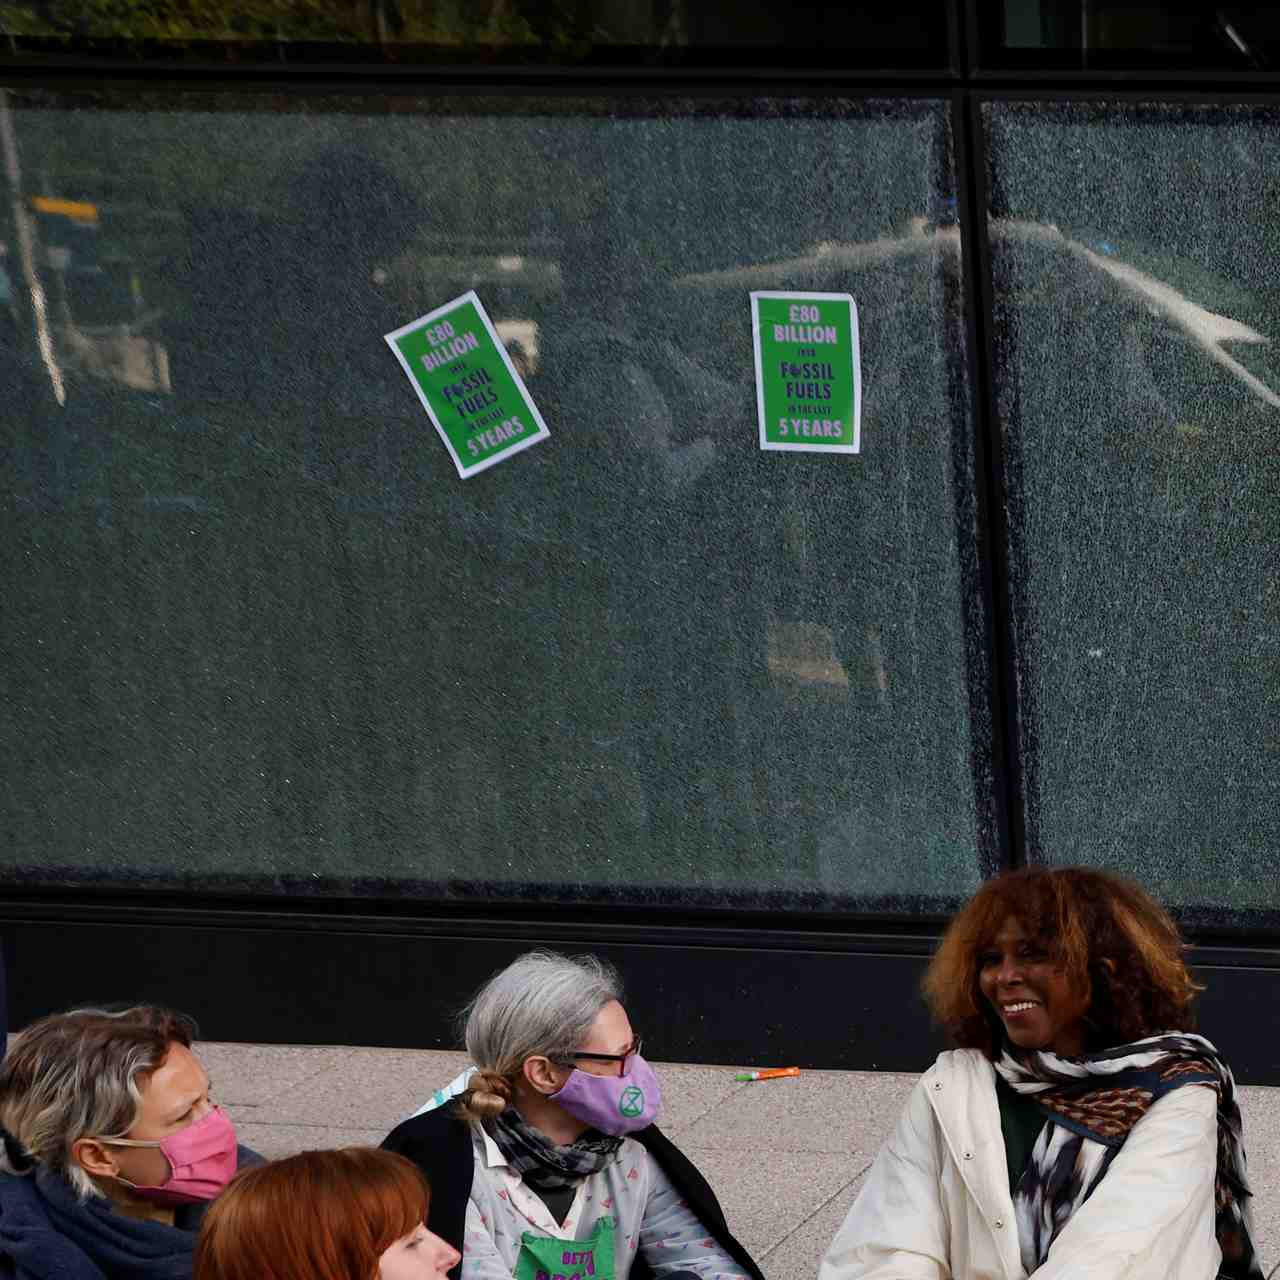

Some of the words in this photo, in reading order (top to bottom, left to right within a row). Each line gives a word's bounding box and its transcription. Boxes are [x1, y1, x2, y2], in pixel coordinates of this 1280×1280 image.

[789, 304, 821, 323] £80
[774, 325, 837, 344] BILLION
[420, 330, 480, 373] BILLION
[786, 383, 832, 400] FUELS
[474, 415, 526, 450] YEARS
[778, 418, 789, 436] 5
[791, 418, 843, 438] YEARS
